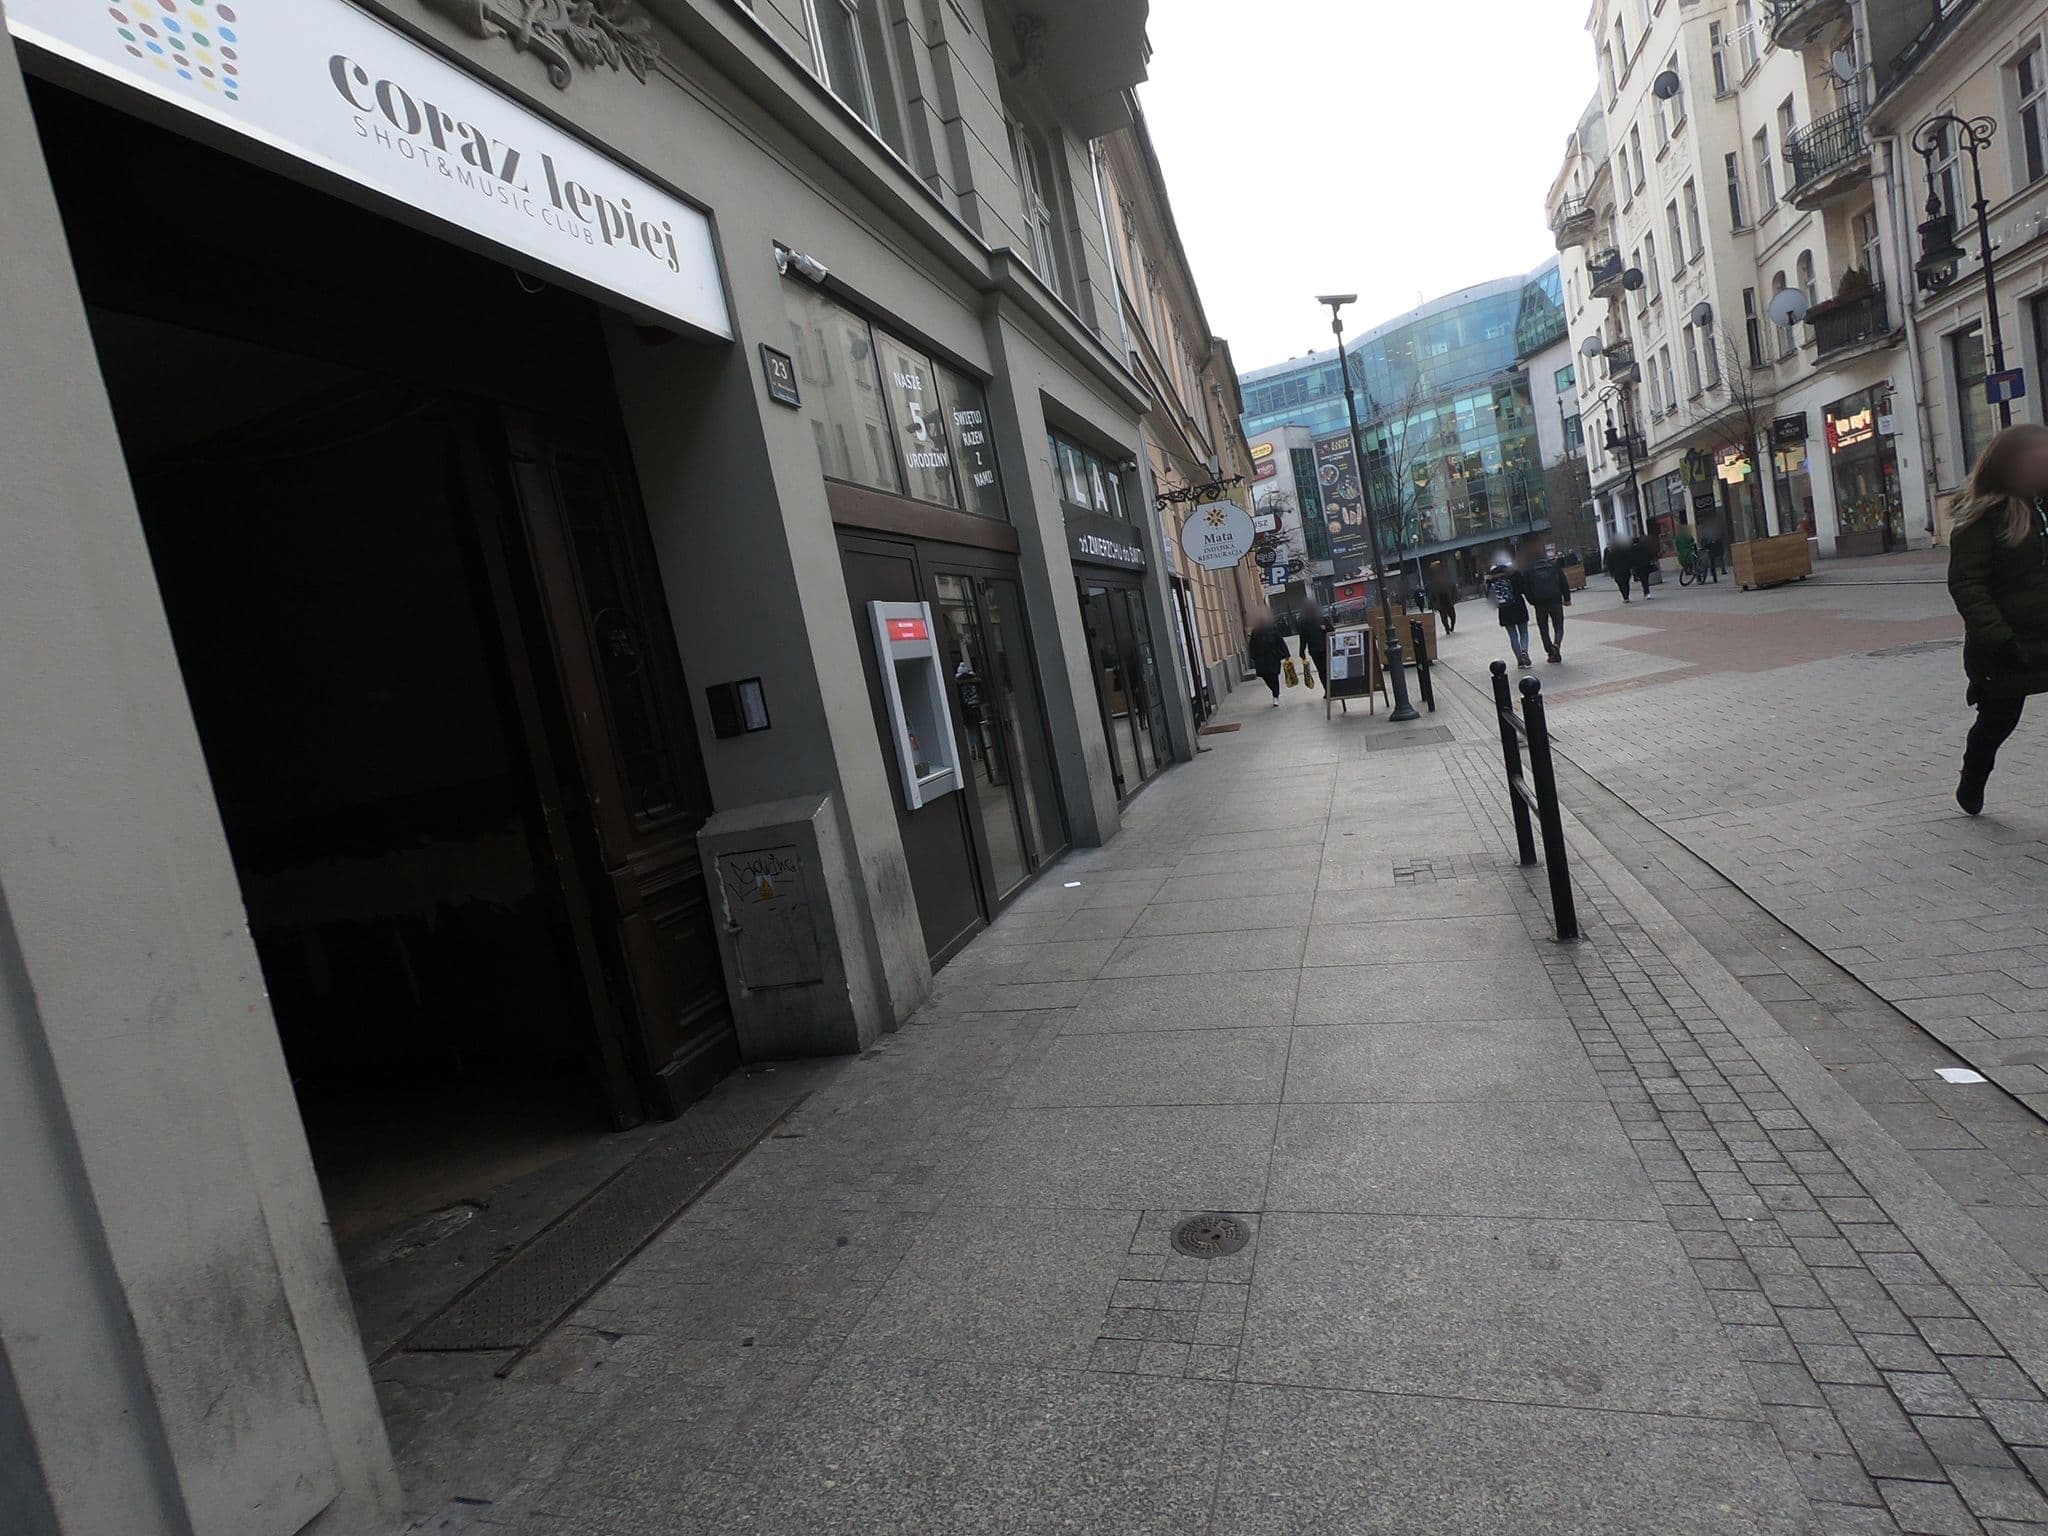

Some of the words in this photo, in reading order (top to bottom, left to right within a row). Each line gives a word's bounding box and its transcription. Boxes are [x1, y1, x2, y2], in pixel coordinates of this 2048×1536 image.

[329, 54, 530, 193] coraz
[540, 152, 681, 273] lepiej
[541, 208, 593, 246] CLUB
[771, 358, 788, 380] 23
[893, 371, 922, 391] NASZE
[908, 402, 928, 441] 5
[962, 431, 985, 446] RAZEM
[905, 452, 949, 469] URODZINY
[1067, 449, 1122, 518] LAT
[1204, 531, 1233, 545] Mata
[1271, 566, 1286, 584] P
